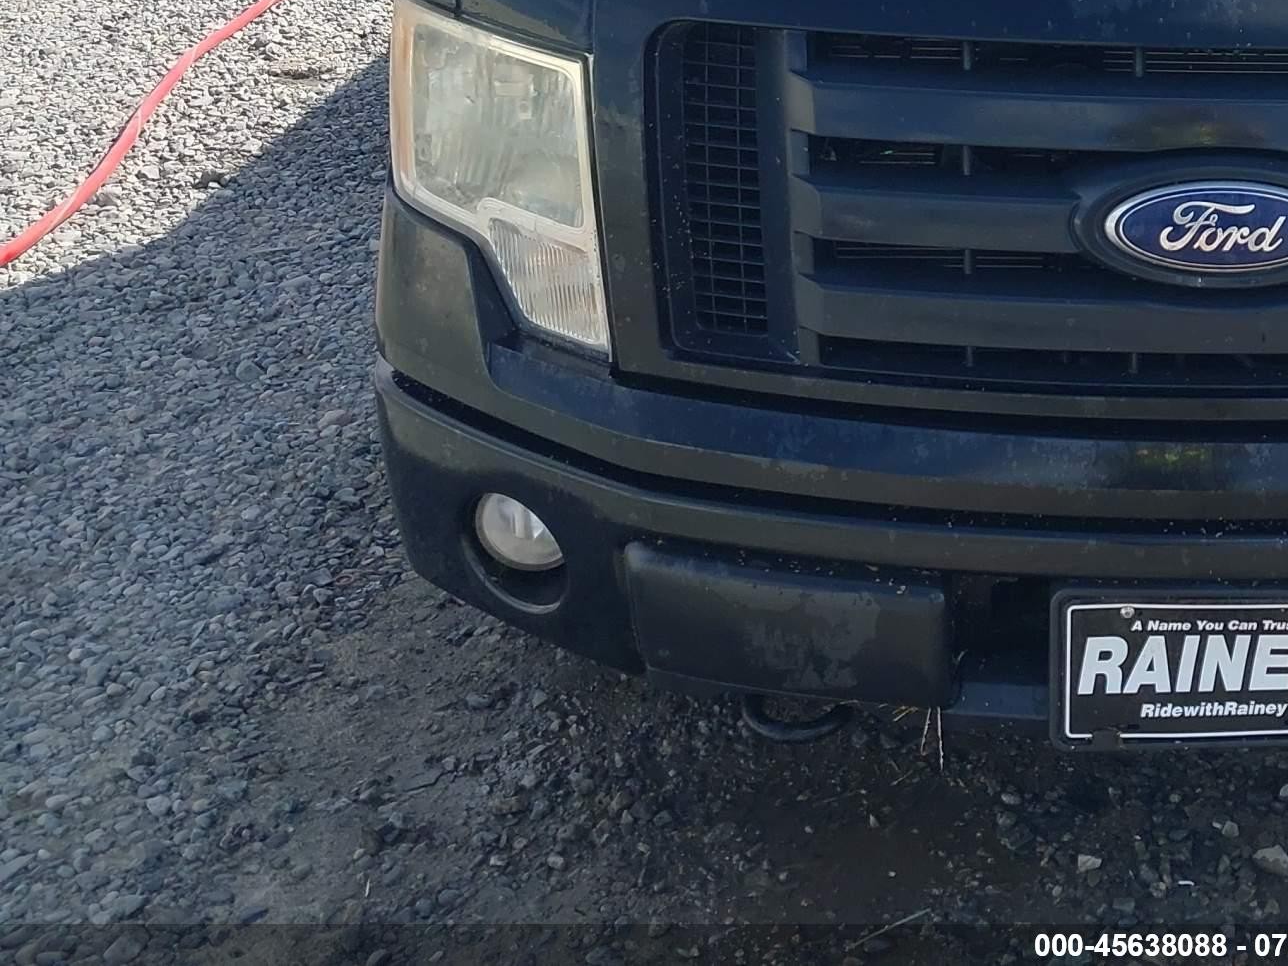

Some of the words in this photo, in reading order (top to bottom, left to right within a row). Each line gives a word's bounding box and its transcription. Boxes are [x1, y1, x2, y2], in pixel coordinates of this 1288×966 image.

[1158, 200, 1287, 252] Ford
[1131, 620, 1143, 631] A
[1147, 620, 1192, 632] Name
[1196, 620, 1224, 631] You
[1228, 620, 1258, 631] Can
[1140, 701, 1288, 718] RidewithRainey
